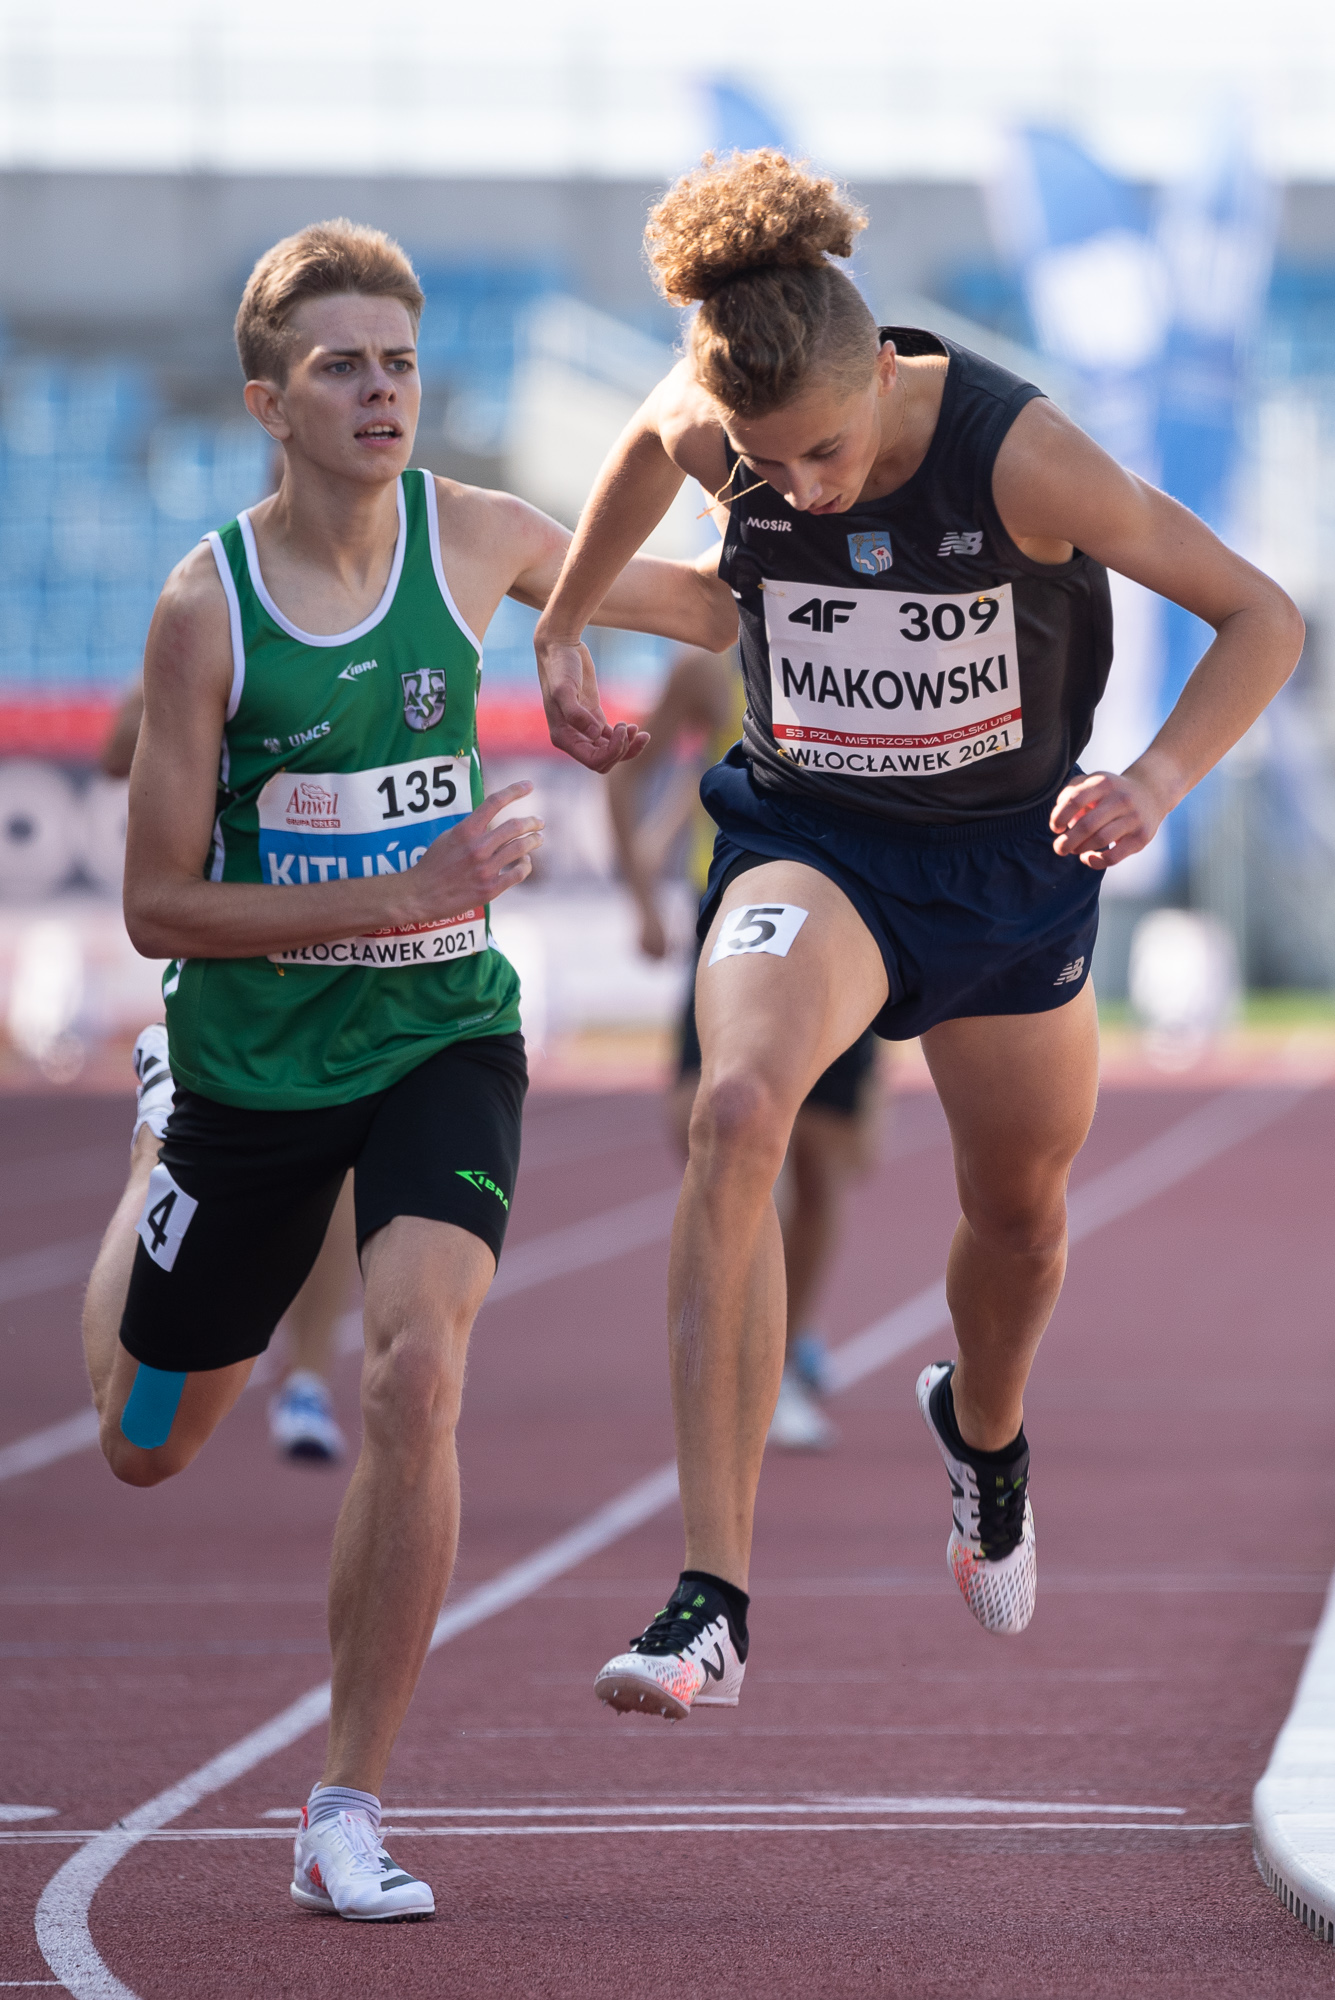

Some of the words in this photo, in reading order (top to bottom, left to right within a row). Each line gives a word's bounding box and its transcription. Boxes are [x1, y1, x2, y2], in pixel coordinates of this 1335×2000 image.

[788, 597, 857, 634] 4F
[898, 597, 1000, 642] 309
[781, 654, 1009, 711] MAKOWSKI
[288, 721, 331, 747] UMCS
[809, 730, 843, 743] PZLA
[845, 735, 941, 746] MISTRZOSTWA
[943, 722, 988, 743] POLSKI
[990, 714, 1012, 728] U18
[788, 747, 952, 773] WŁOCŁAWEK
[958, 730, 1012, 763] 2021
[285, 786, 339, 815] Anwil
[377, 763, 457, 821] 135
[312, 819, 341, 828] ORLEN
[432, 929, 476, 958] 2021
[727, 907, 785, 950] 5
[147, 1189, 178, 1255] 4
